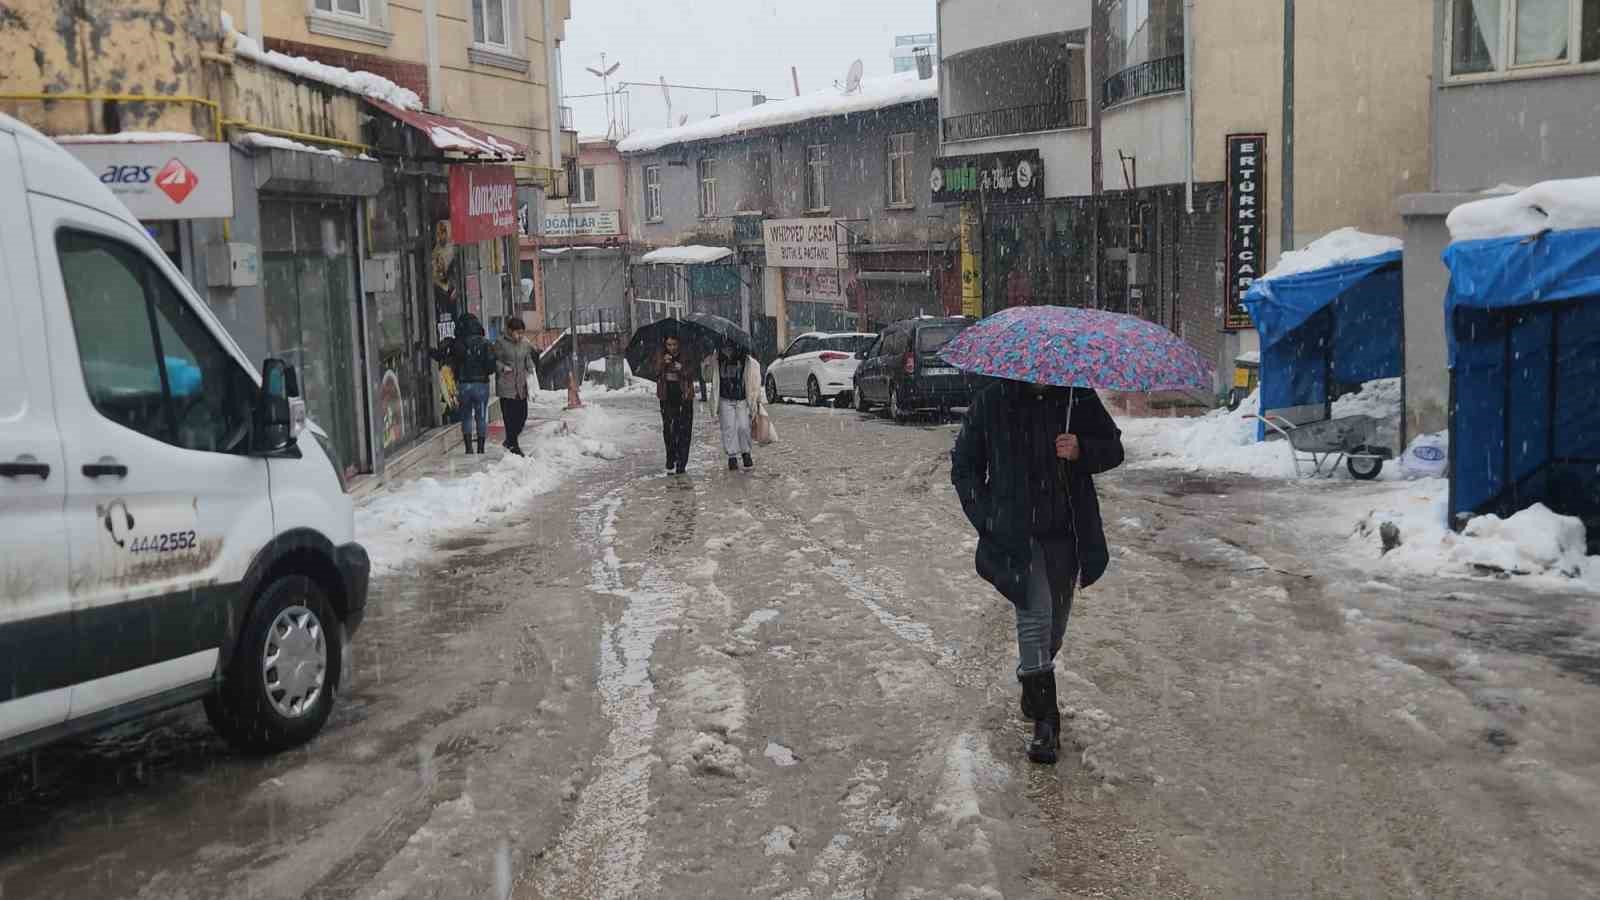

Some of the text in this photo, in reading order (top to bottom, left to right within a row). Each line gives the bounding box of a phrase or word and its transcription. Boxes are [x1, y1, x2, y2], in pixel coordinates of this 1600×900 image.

[99, 164, 155, 184] aras
[768, 225, 804, 242] WHIPPED
[130, 530, 196, 554] 4442552
